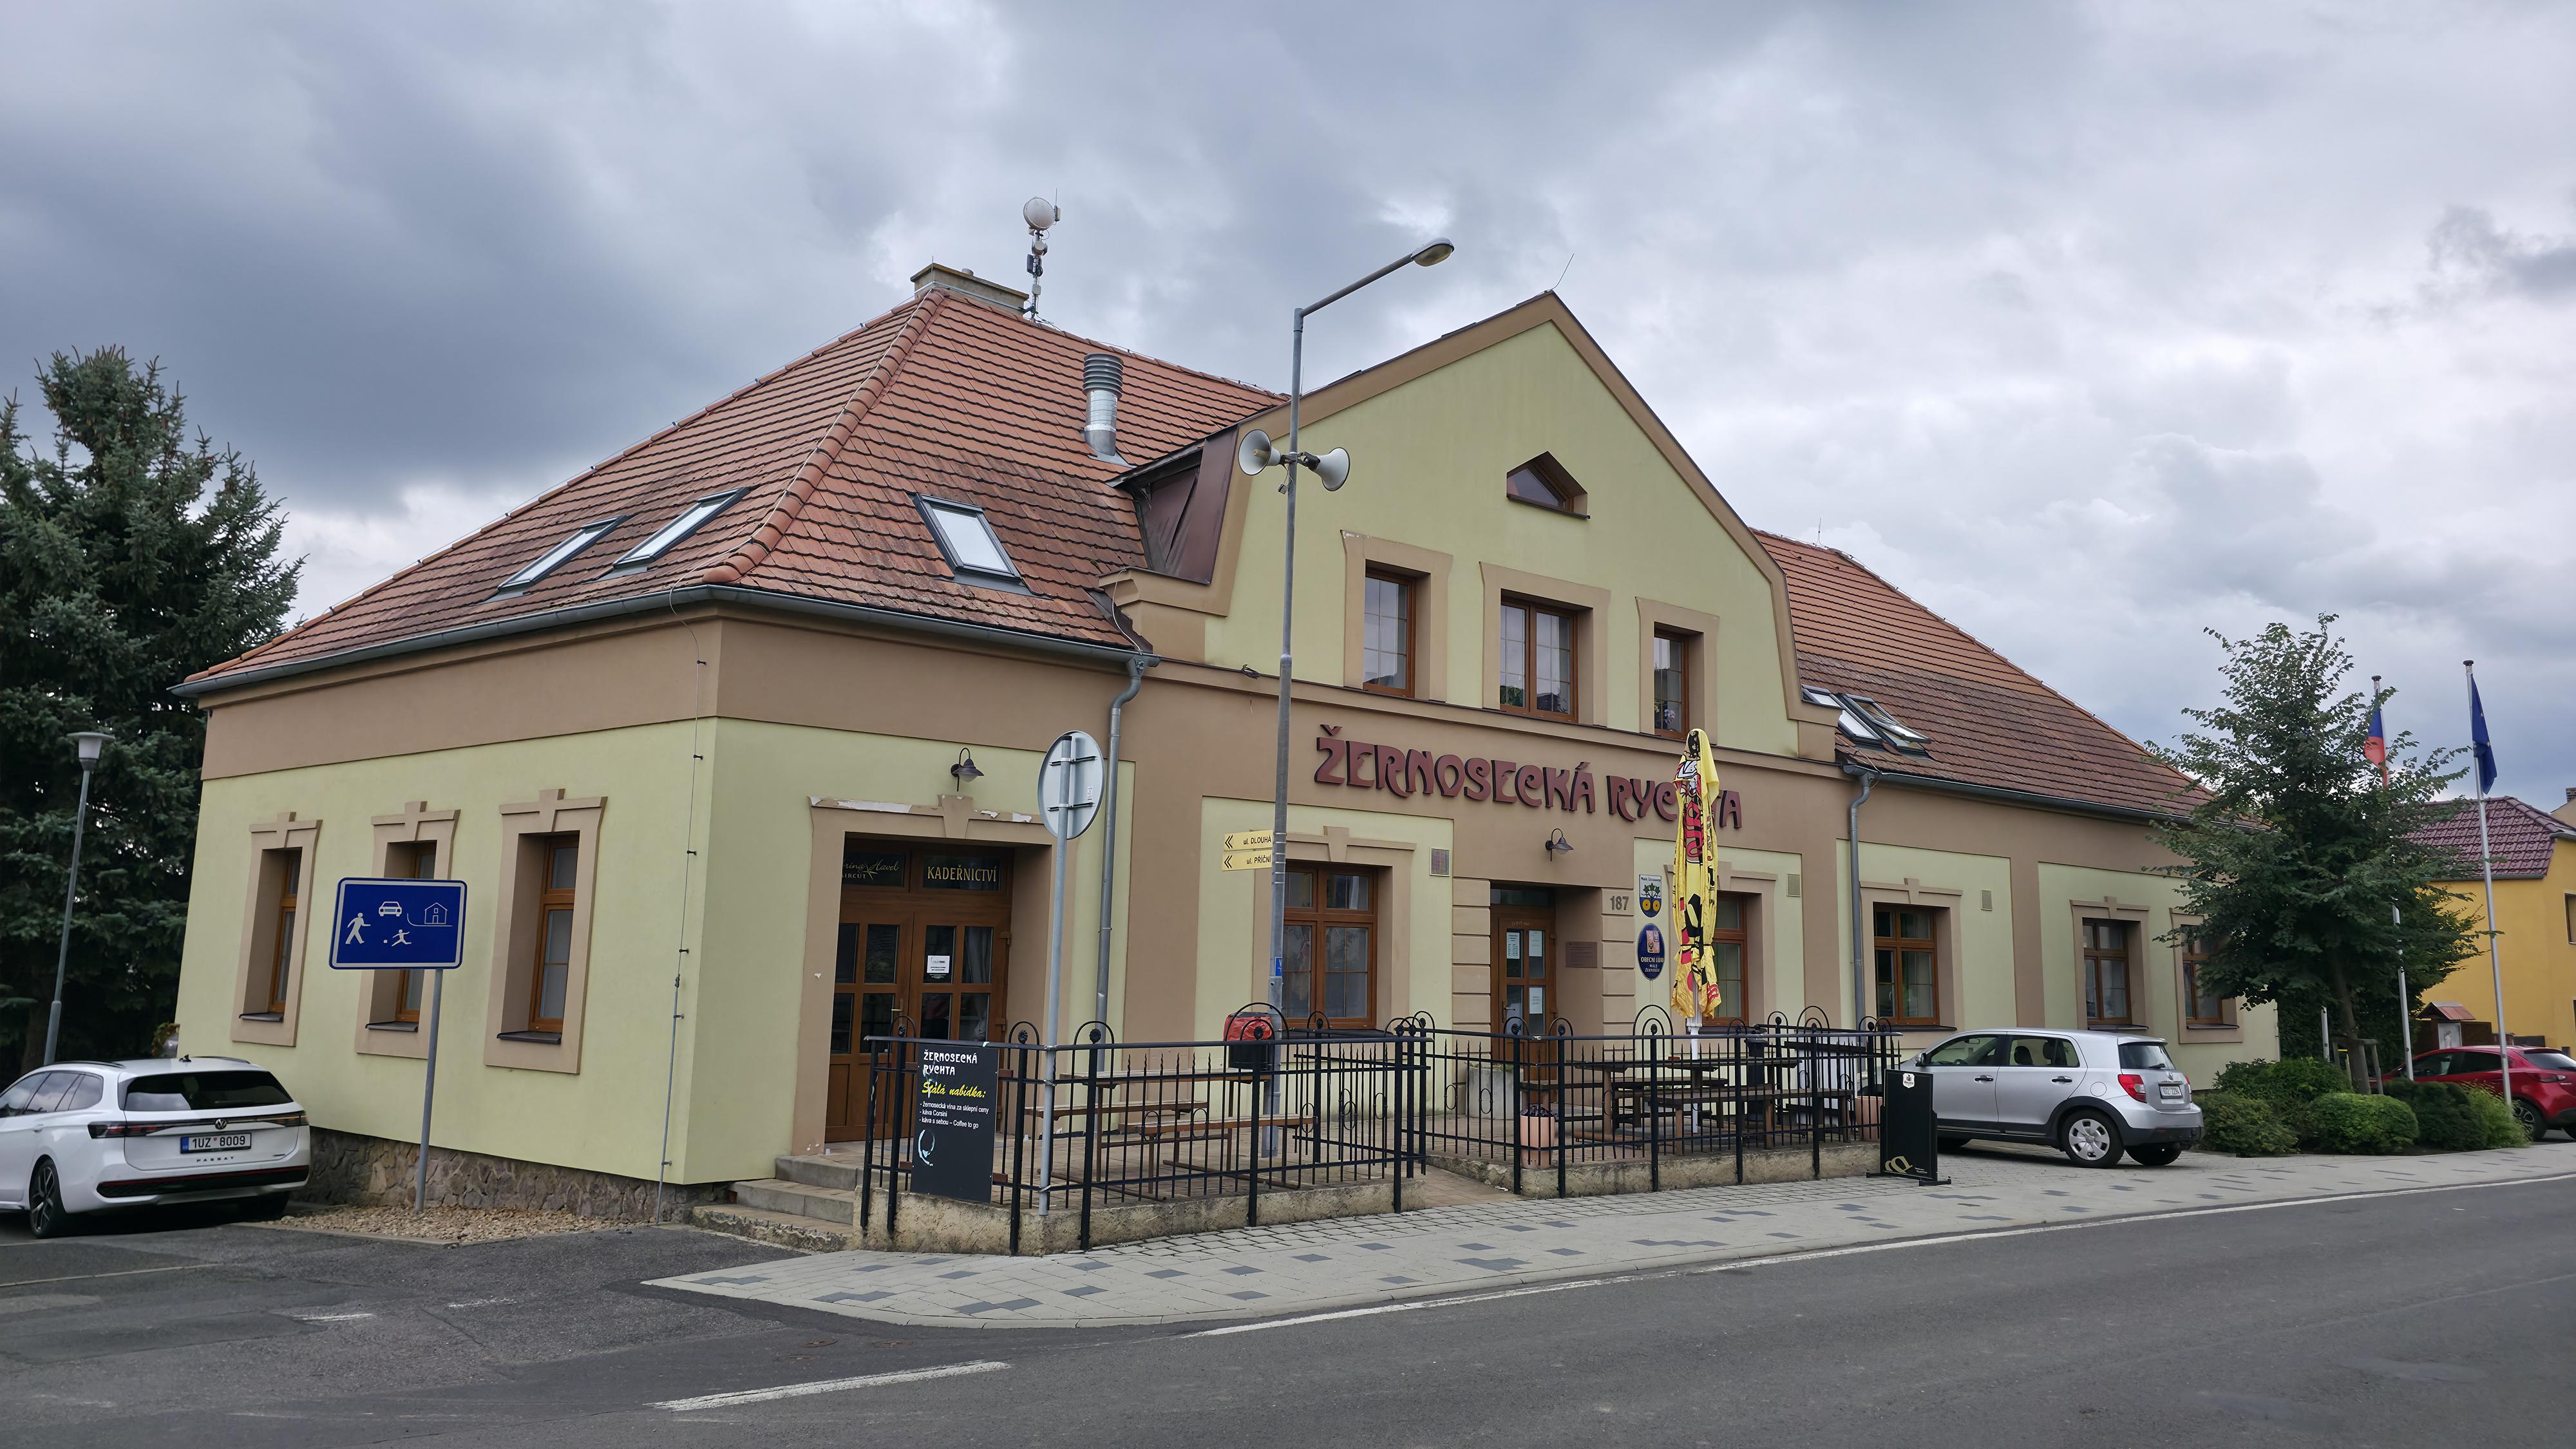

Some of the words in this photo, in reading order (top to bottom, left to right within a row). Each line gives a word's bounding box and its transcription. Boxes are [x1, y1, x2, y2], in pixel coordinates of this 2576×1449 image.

[1314, 724, 1596, 813] ŽERNOSECKÁ
[1251, 835, 1271, 844] DLOUHÁ
[1254, 855, 1271, 864] PŘÍČNÍ
[927, 864, 997, 882] KADEŘNICTVÍ
[1610, 895, 1630, 911] 187
[923, 1049, 978, 1064] ŽERNOSECKÁ
[923, 1065, 955, 1075] RYCHTA
[922, 1081, 946, 1094] Stálá
[949, 1084, 986, 1098] nabídka:
[192, 1137, 211, 1148] 1UZ
[220, 1135, 245, 1146] 8009
